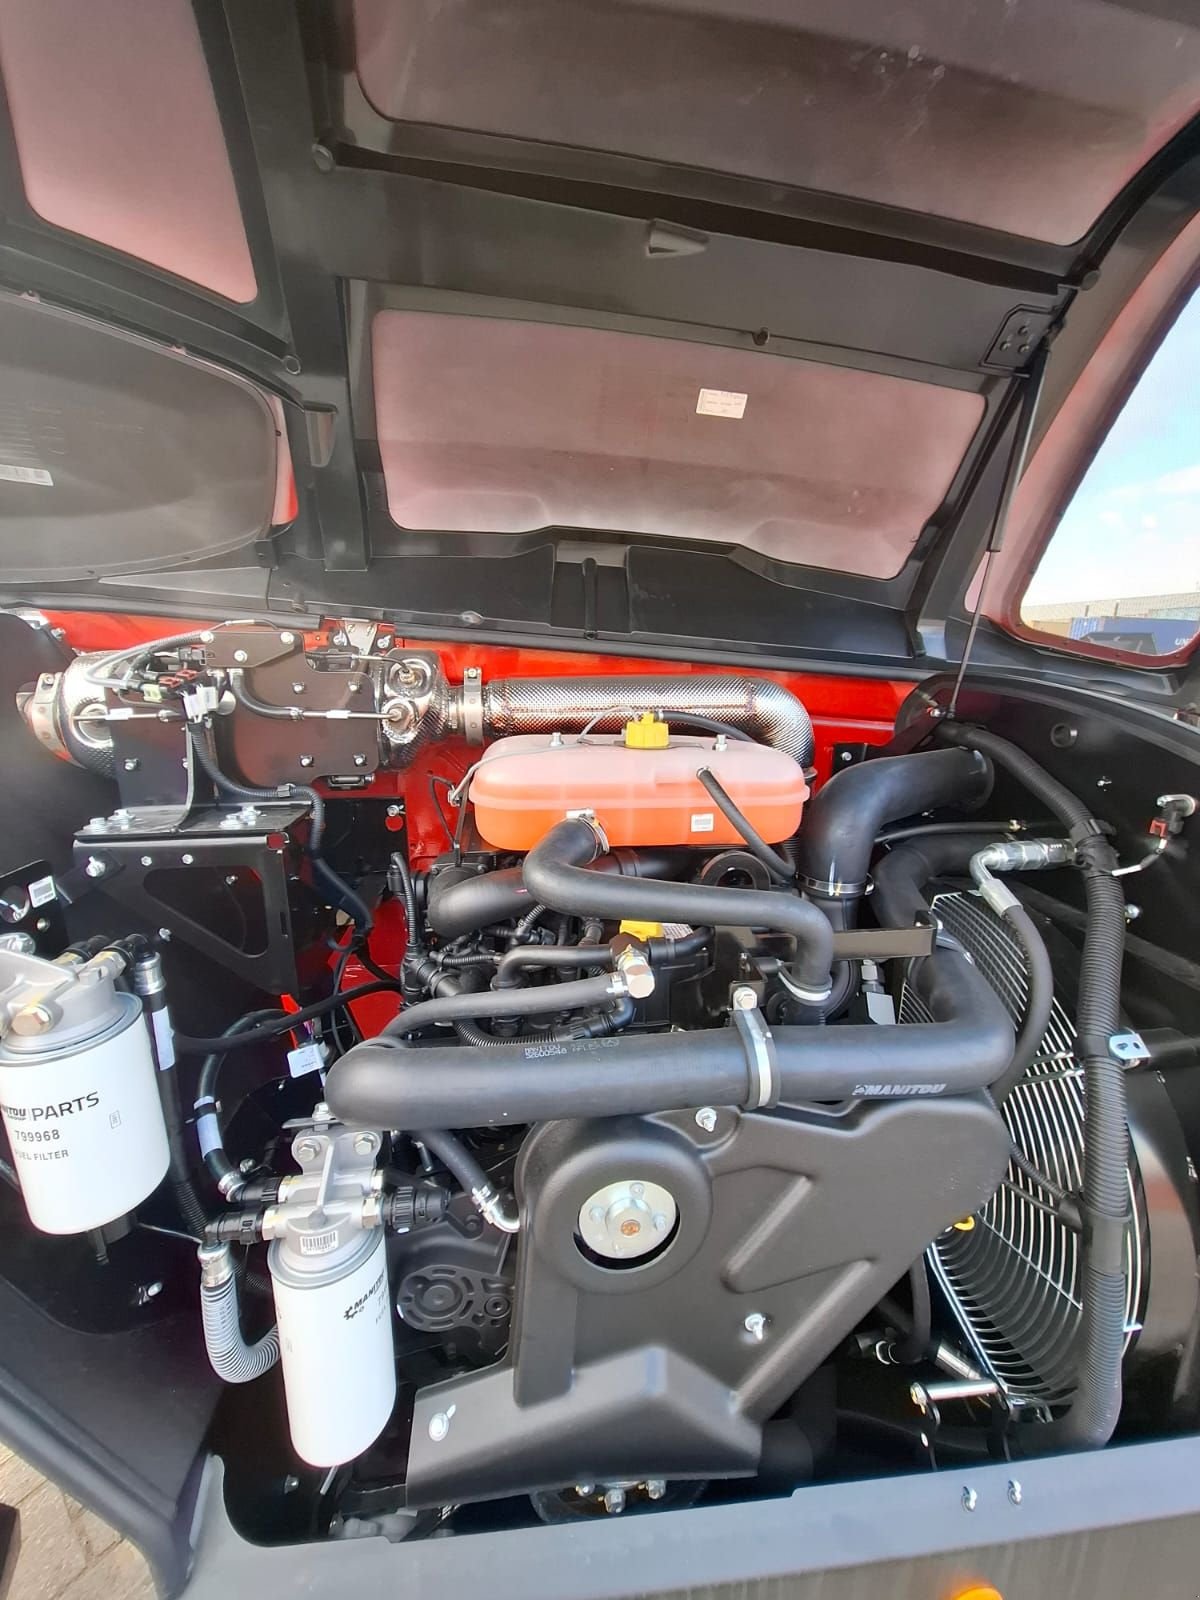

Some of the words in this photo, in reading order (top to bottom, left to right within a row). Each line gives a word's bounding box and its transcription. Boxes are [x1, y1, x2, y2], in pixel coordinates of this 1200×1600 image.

[864, 1083, 947, 1096] MANITOU
[32, 1091, 99, 1121] PARTS
[14, 1129, 60, 1142] 799968
[33, 1149, 69, 1161] FILTER
